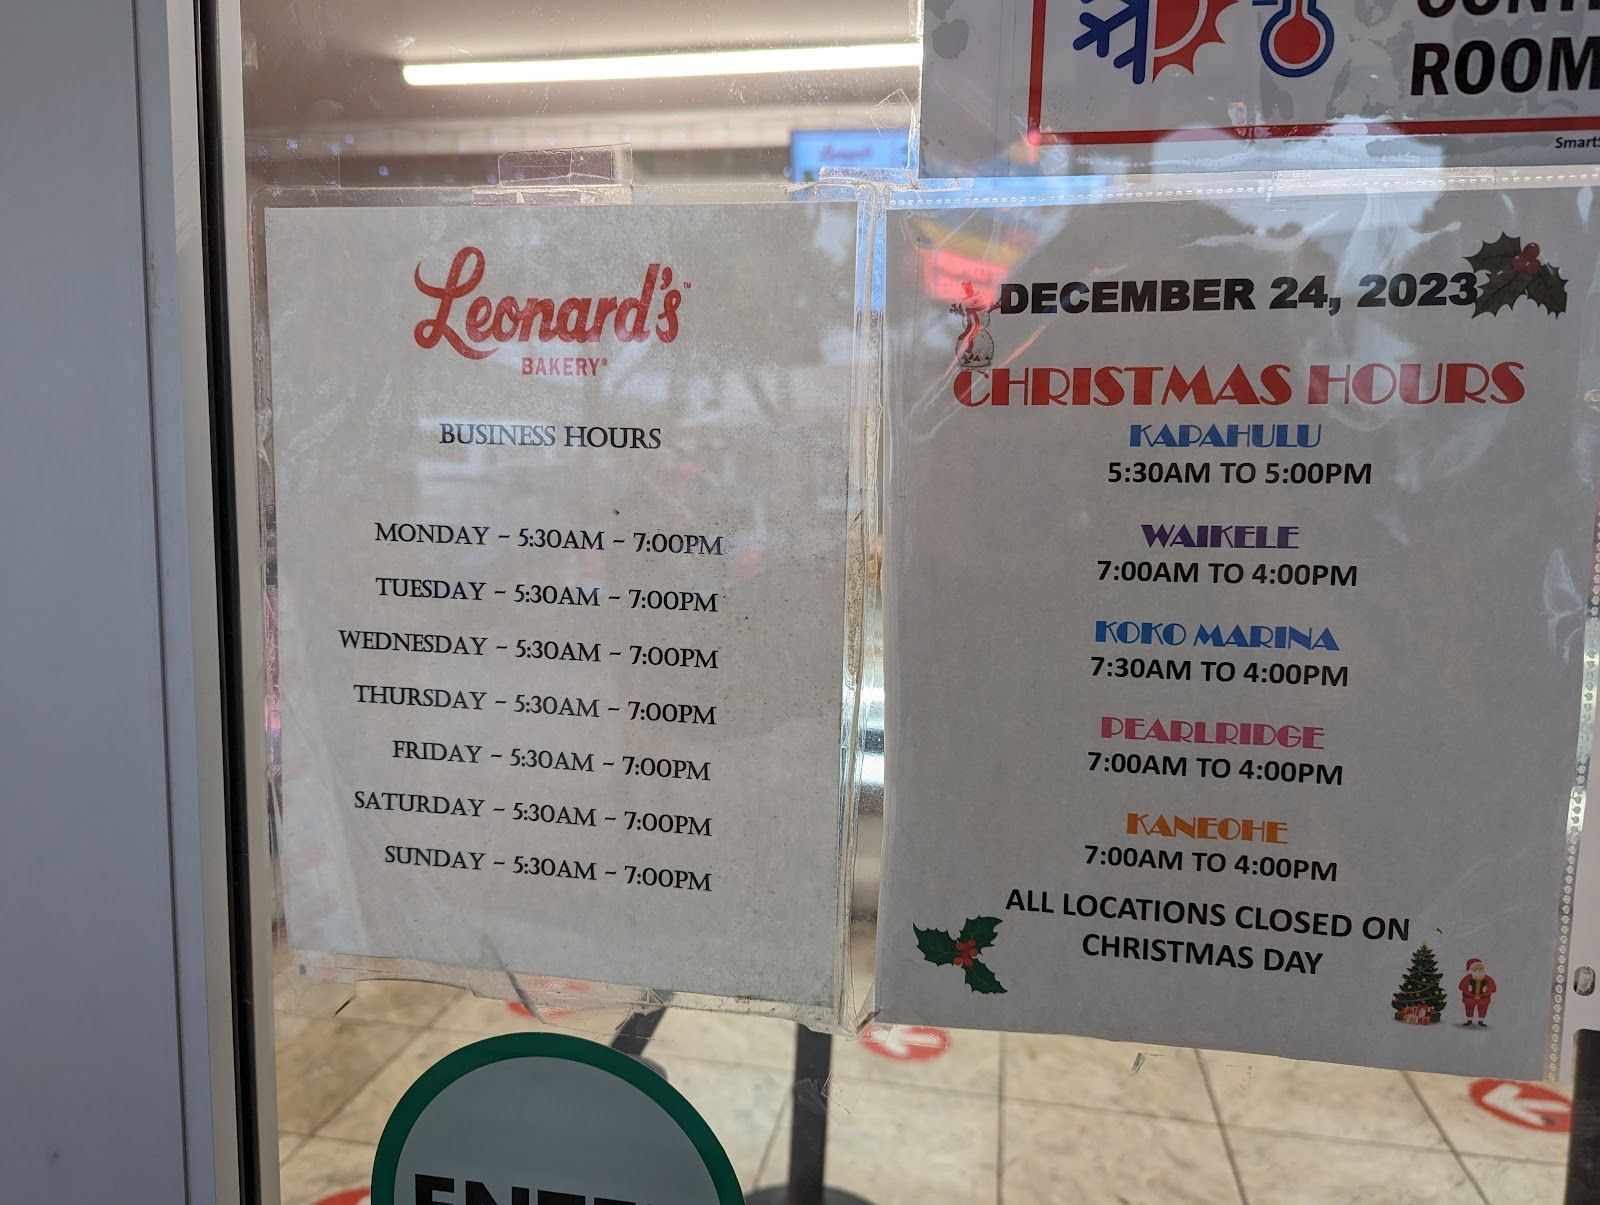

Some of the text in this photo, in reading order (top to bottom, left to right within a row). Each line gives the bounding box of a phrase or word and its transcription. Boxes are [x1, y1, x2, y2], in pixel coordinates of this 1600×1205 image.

[1411, 36, 1600, 95] ROOM
[1555, 136, 1600, 148] Smart
[414, 247, 681, 360] Leonard's
[1001, 272, 1478, 315] DECEMBER 24, 2023
[953, 361, 1525, 407] CHRISTMAS HOURS
[439, 423, 661, 448] BUSINESS HOURS
[1129, 424, 1322, 448] KAPAHULU
[1108, 462, 1372, 485] 5:30AM TO 5:00PM
[375, 522, 489, 545] MONDAY
[517, 528, 604, 550] 5:30AM
[633, 532, 723, 555] 7:00PM
[1141, 524, 1299, 549] WAIKELE
[1097, 561, 1358, 587] 7:00AM TO 4:00PM
[376, 577, 486, 600] TUESDAY
[514, 584, 600, 606] 5:30AM
[629, 589, 718, 612] 7:00PM
[338, 629, 488, 655] WEDNESDAY
[515, 639, 601, 662] 5:30AM
[630, 645, 718, 669] 7:00PM
[1095, 621, 1340, 651] KOKO MARINA
[1090, 657, 1349, 687] 7:30AM TO 4:00PM
[354, 684, 487, 709] THURSDAY
[514, 694, 600, 717] 5:30AM
[628, 701, 716, 725] 7:00PM
[1101, 716, 1325, 750] PEARLRIDGE
[392, 740, 482, 763] FRIDAY
[510, 749, 594, 772] 5:30AM
[622, 756, 710, 781] 7:00PM
[1087, 752, 1343, 786] 7:00AM TO 4:00PM
[354, 791, 484, 817] SATURDAY
[512, 802, 597, 826] 5:30AM
[624, 811, 712, 836] 7:00PM
[1126, 813, 1289, 844] KANEOHE
[385, 845, 485, 870] SUNDAY
[512, 855, 597, 880] 5:30AM
[624, 866, 712, 891] 7:00PM
[1084, 845, 1338, 882] 7:00AM TO 4:00PM
[1005, 889, 1410, 941] ALL LOCATIONS CLOSED ON
[1082, 933, 1324, 975] CHRISTMAS DAY
